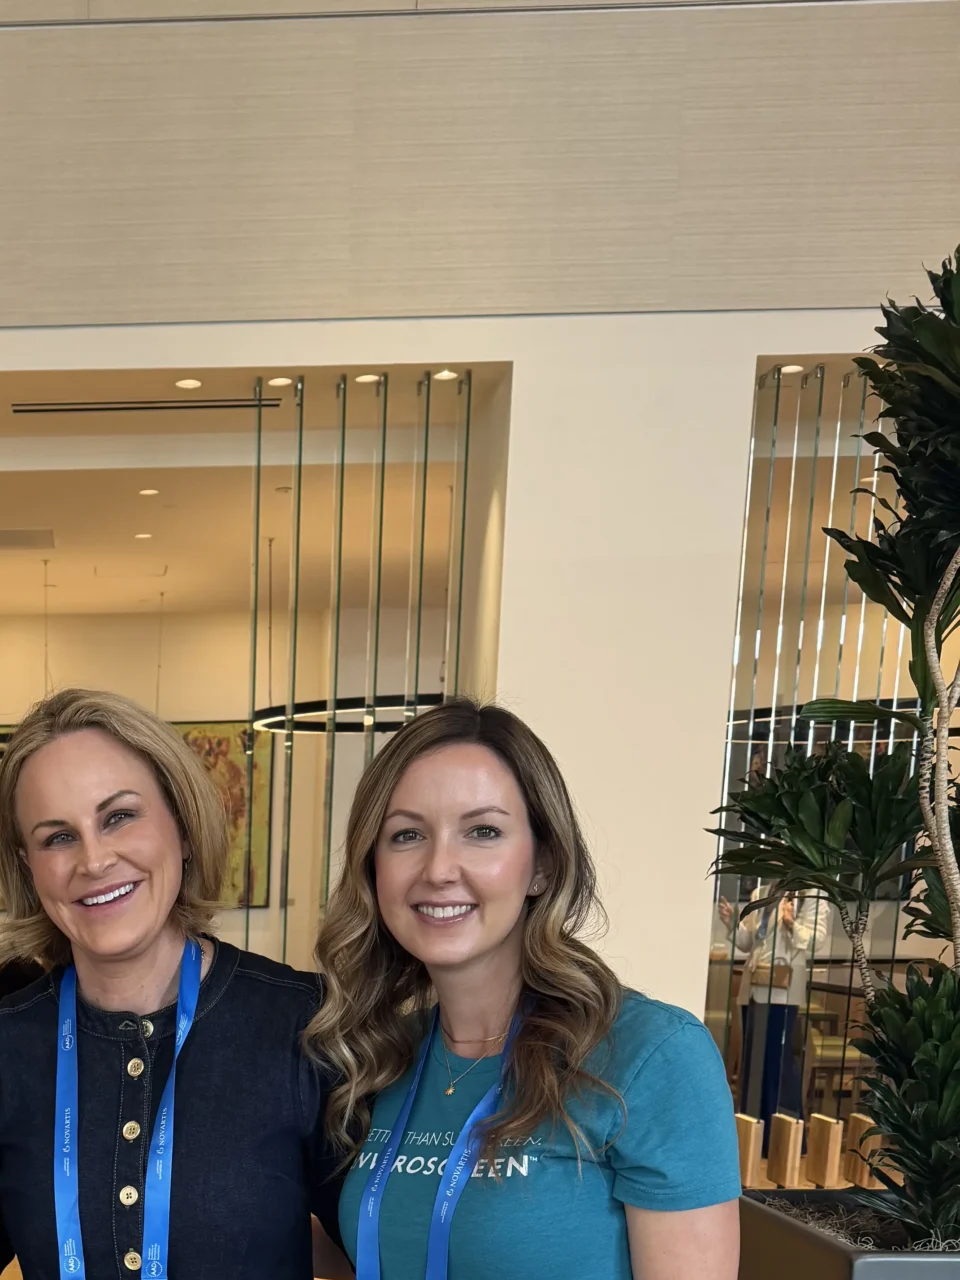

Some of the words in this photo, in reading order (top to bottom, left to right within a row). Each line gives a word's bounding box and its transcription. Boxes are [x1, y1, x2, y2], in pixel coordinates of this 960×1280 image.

[158, 1107, 167, 1146] NOVARTIS
[404, 1131, 442, 1146] THAN
[450, 1148, 472, 1188] NOVARTIS
